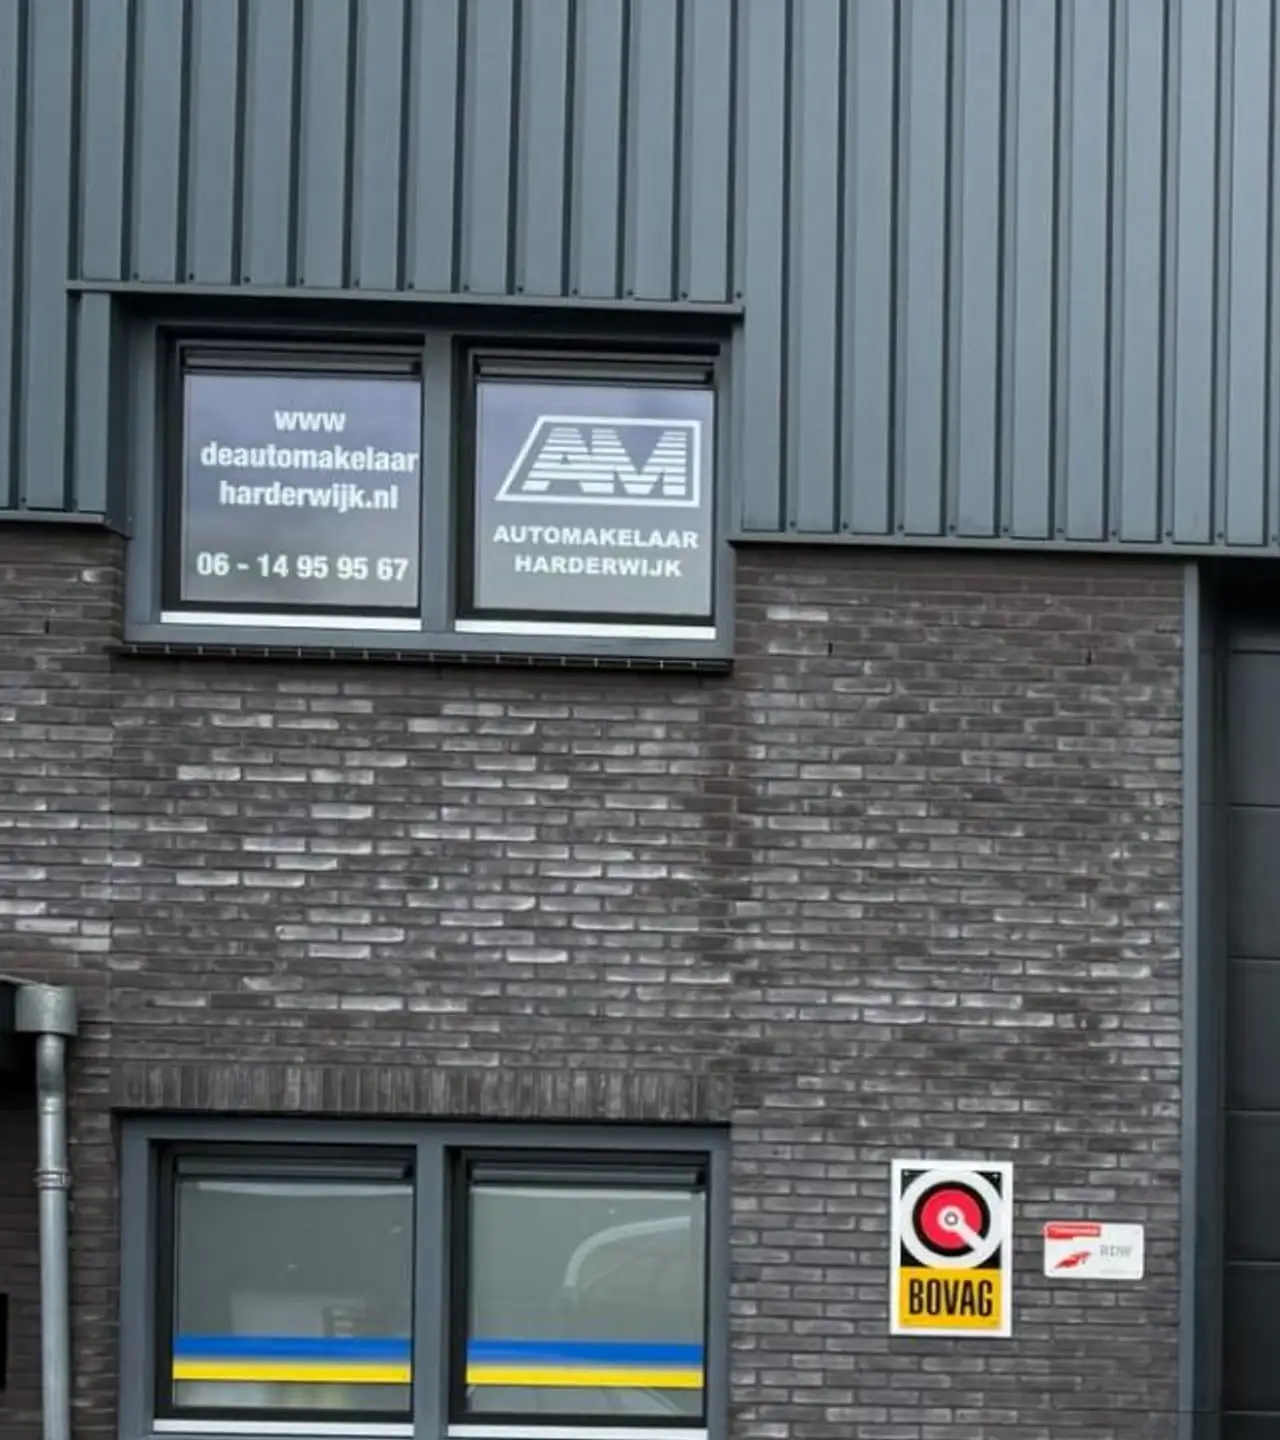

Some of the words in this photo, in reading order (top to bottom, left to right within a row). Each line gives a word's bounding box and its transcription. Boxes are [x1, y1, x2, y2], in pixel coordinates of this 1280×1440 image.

[274, 410, 346, 432] www
[200, 441, 419, 472] deautomakelaar
[521, 427, 688, 495] AM
[219, 480, 398, 513] harderwijk.nl
[493, 525, 699, 549] AUTOMAKELAAR
[196, 552, 230, 576] 06
[257, 554, 289, 577] 14
[296, 555, 329, 579] 95
[336, 556, 369, 580] 95
[376, 558, 409, 581] 67
[514, 555, 684, 577] HARDERWIJK
[908, 1278, 992, 1317] BOVAG
